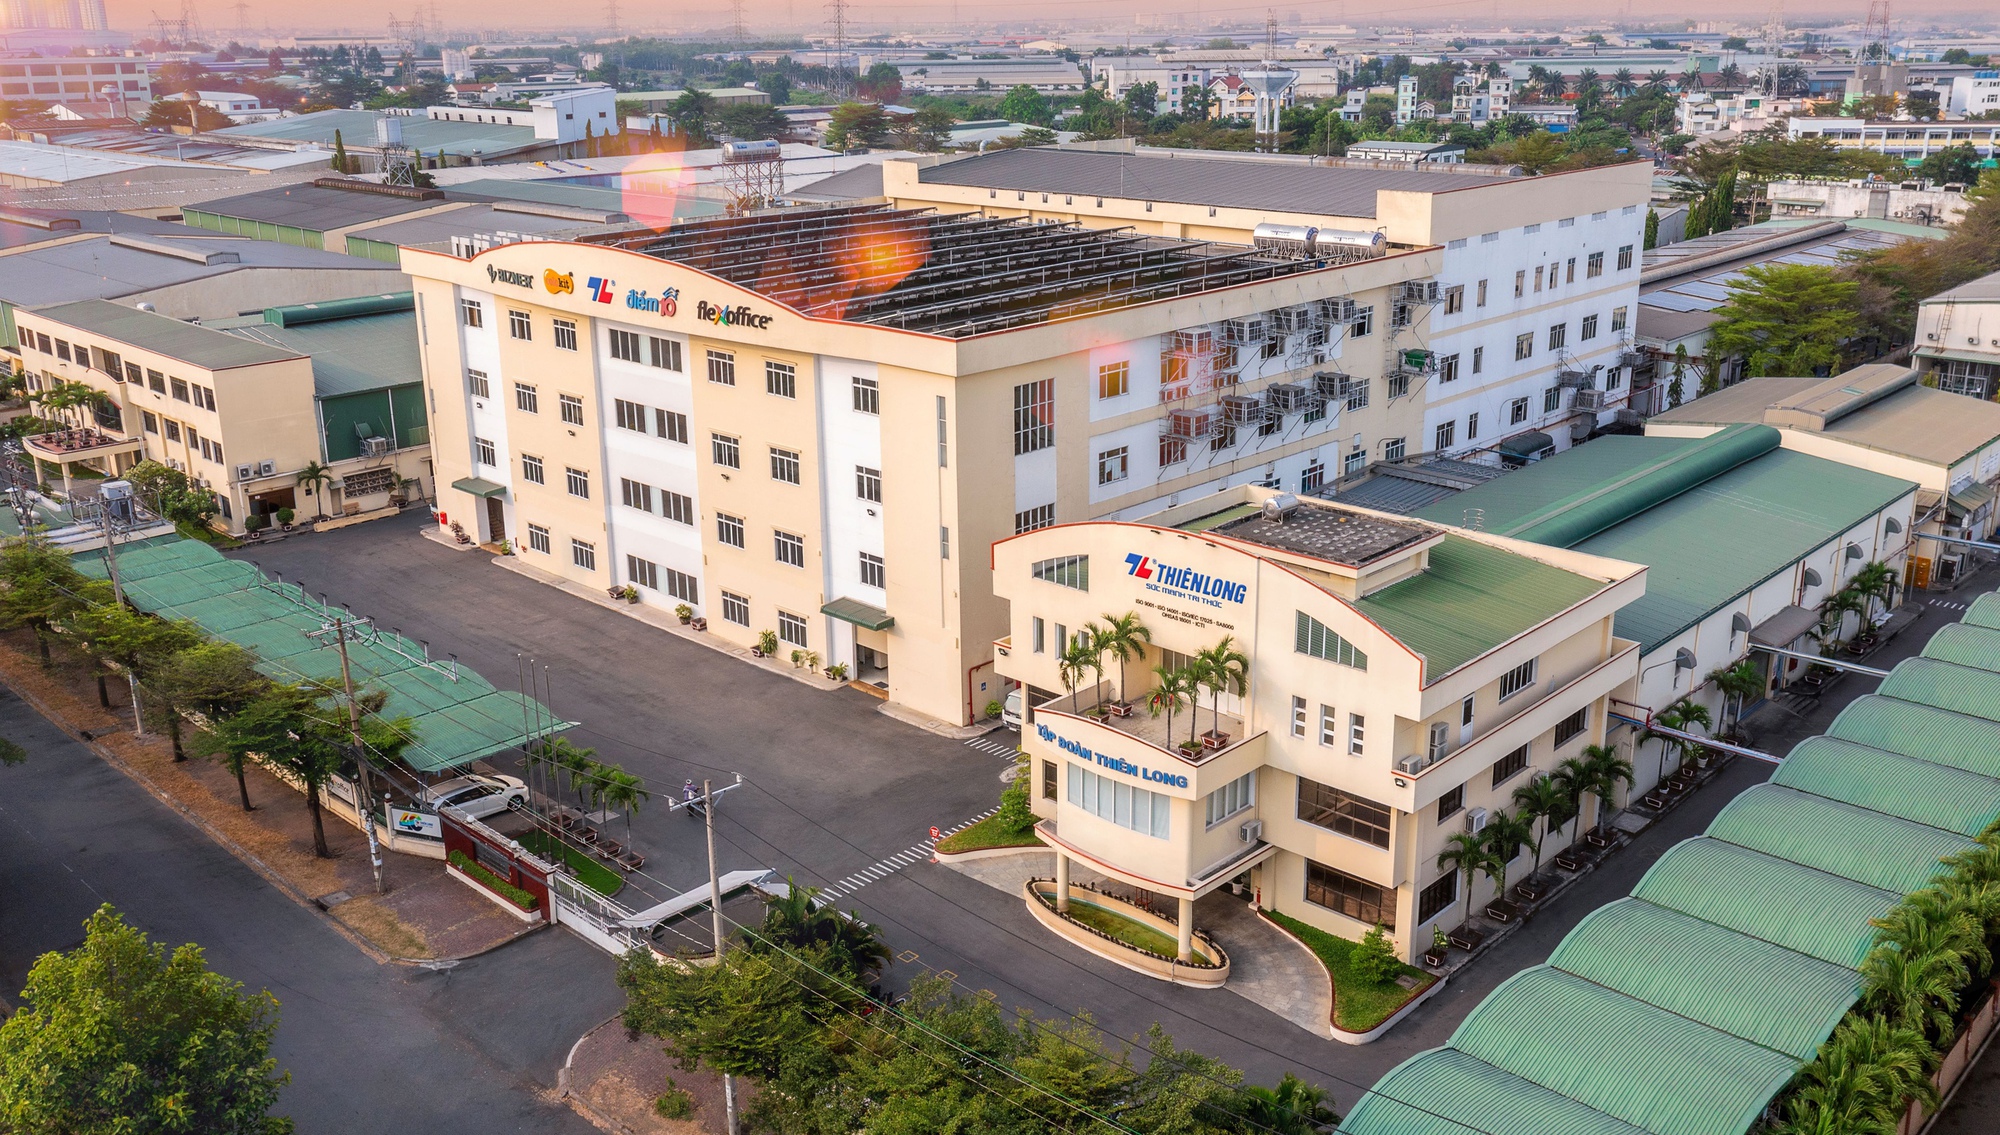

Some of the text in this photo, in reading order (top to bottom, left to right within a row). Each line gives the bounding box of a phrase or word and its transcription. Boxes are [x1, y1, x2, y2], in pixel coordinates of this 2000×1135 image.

[497, 268, 533, 290] BIZNER
[1157, 604, 1165, 612] ISO
[1036, 723, 1188, 789] TẬP ĐOÀN THIÊN LONG
